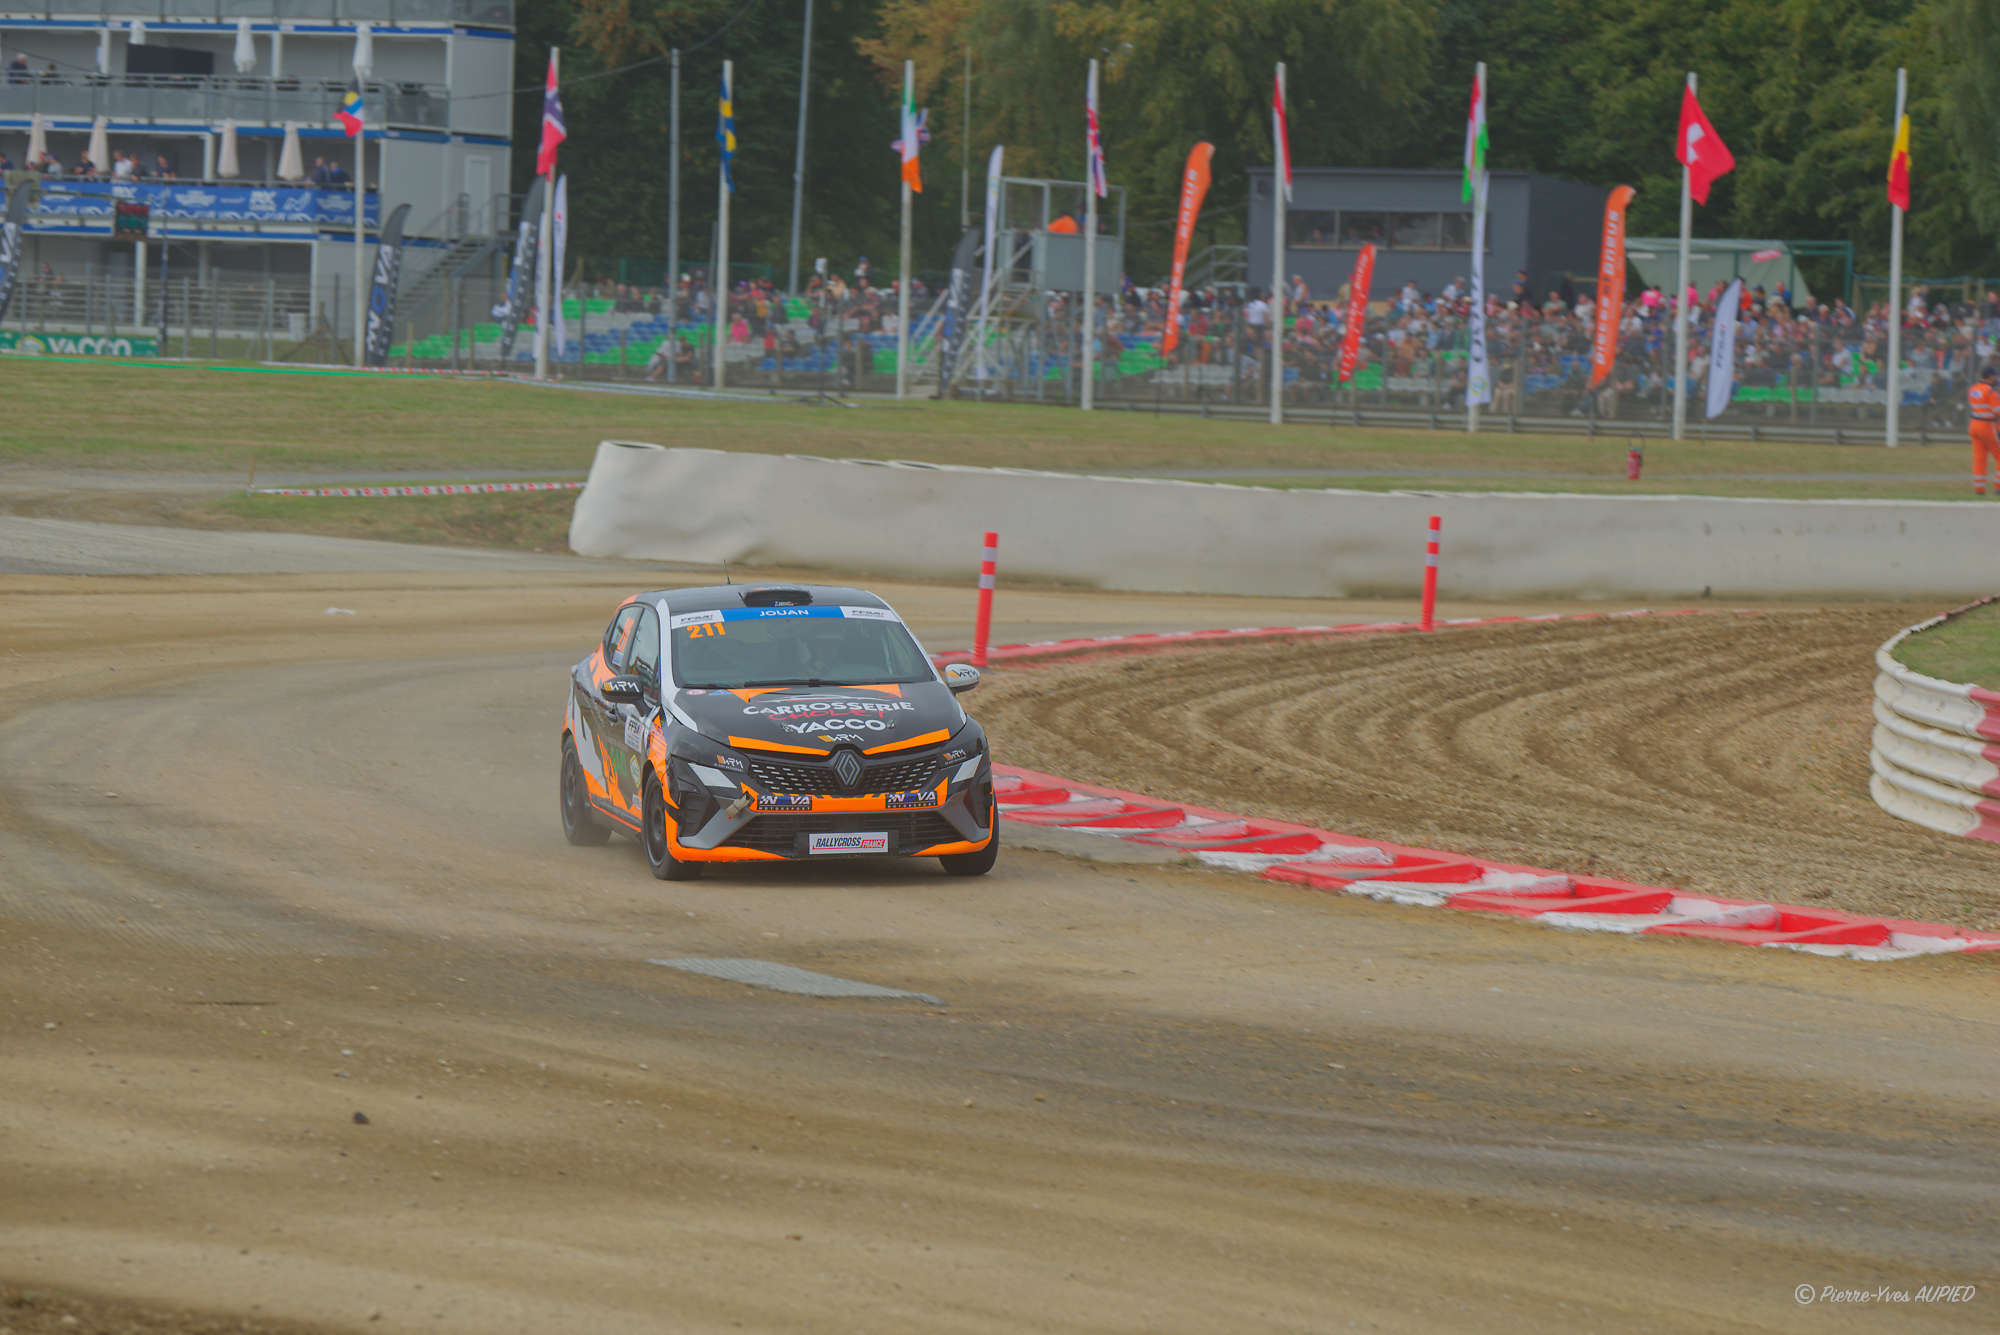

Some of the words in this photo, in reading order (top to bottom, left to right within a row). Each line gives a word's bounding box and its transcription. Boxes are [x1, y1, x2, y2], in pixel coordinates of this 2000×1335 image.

[47, 337, 133, 356] YACCO
[759, 609, 809, 617] JOUAN
[686, 621, 727, 639] 211
[743, 701, 915, 715] CARROSSERIE
[768, 709, 888, 720] CHOLET
[788, 719, 887, 734] YACCO
[815, 836, 862, 848] RALLYCROSS
[862, 839, 886, 848] FRANCE
